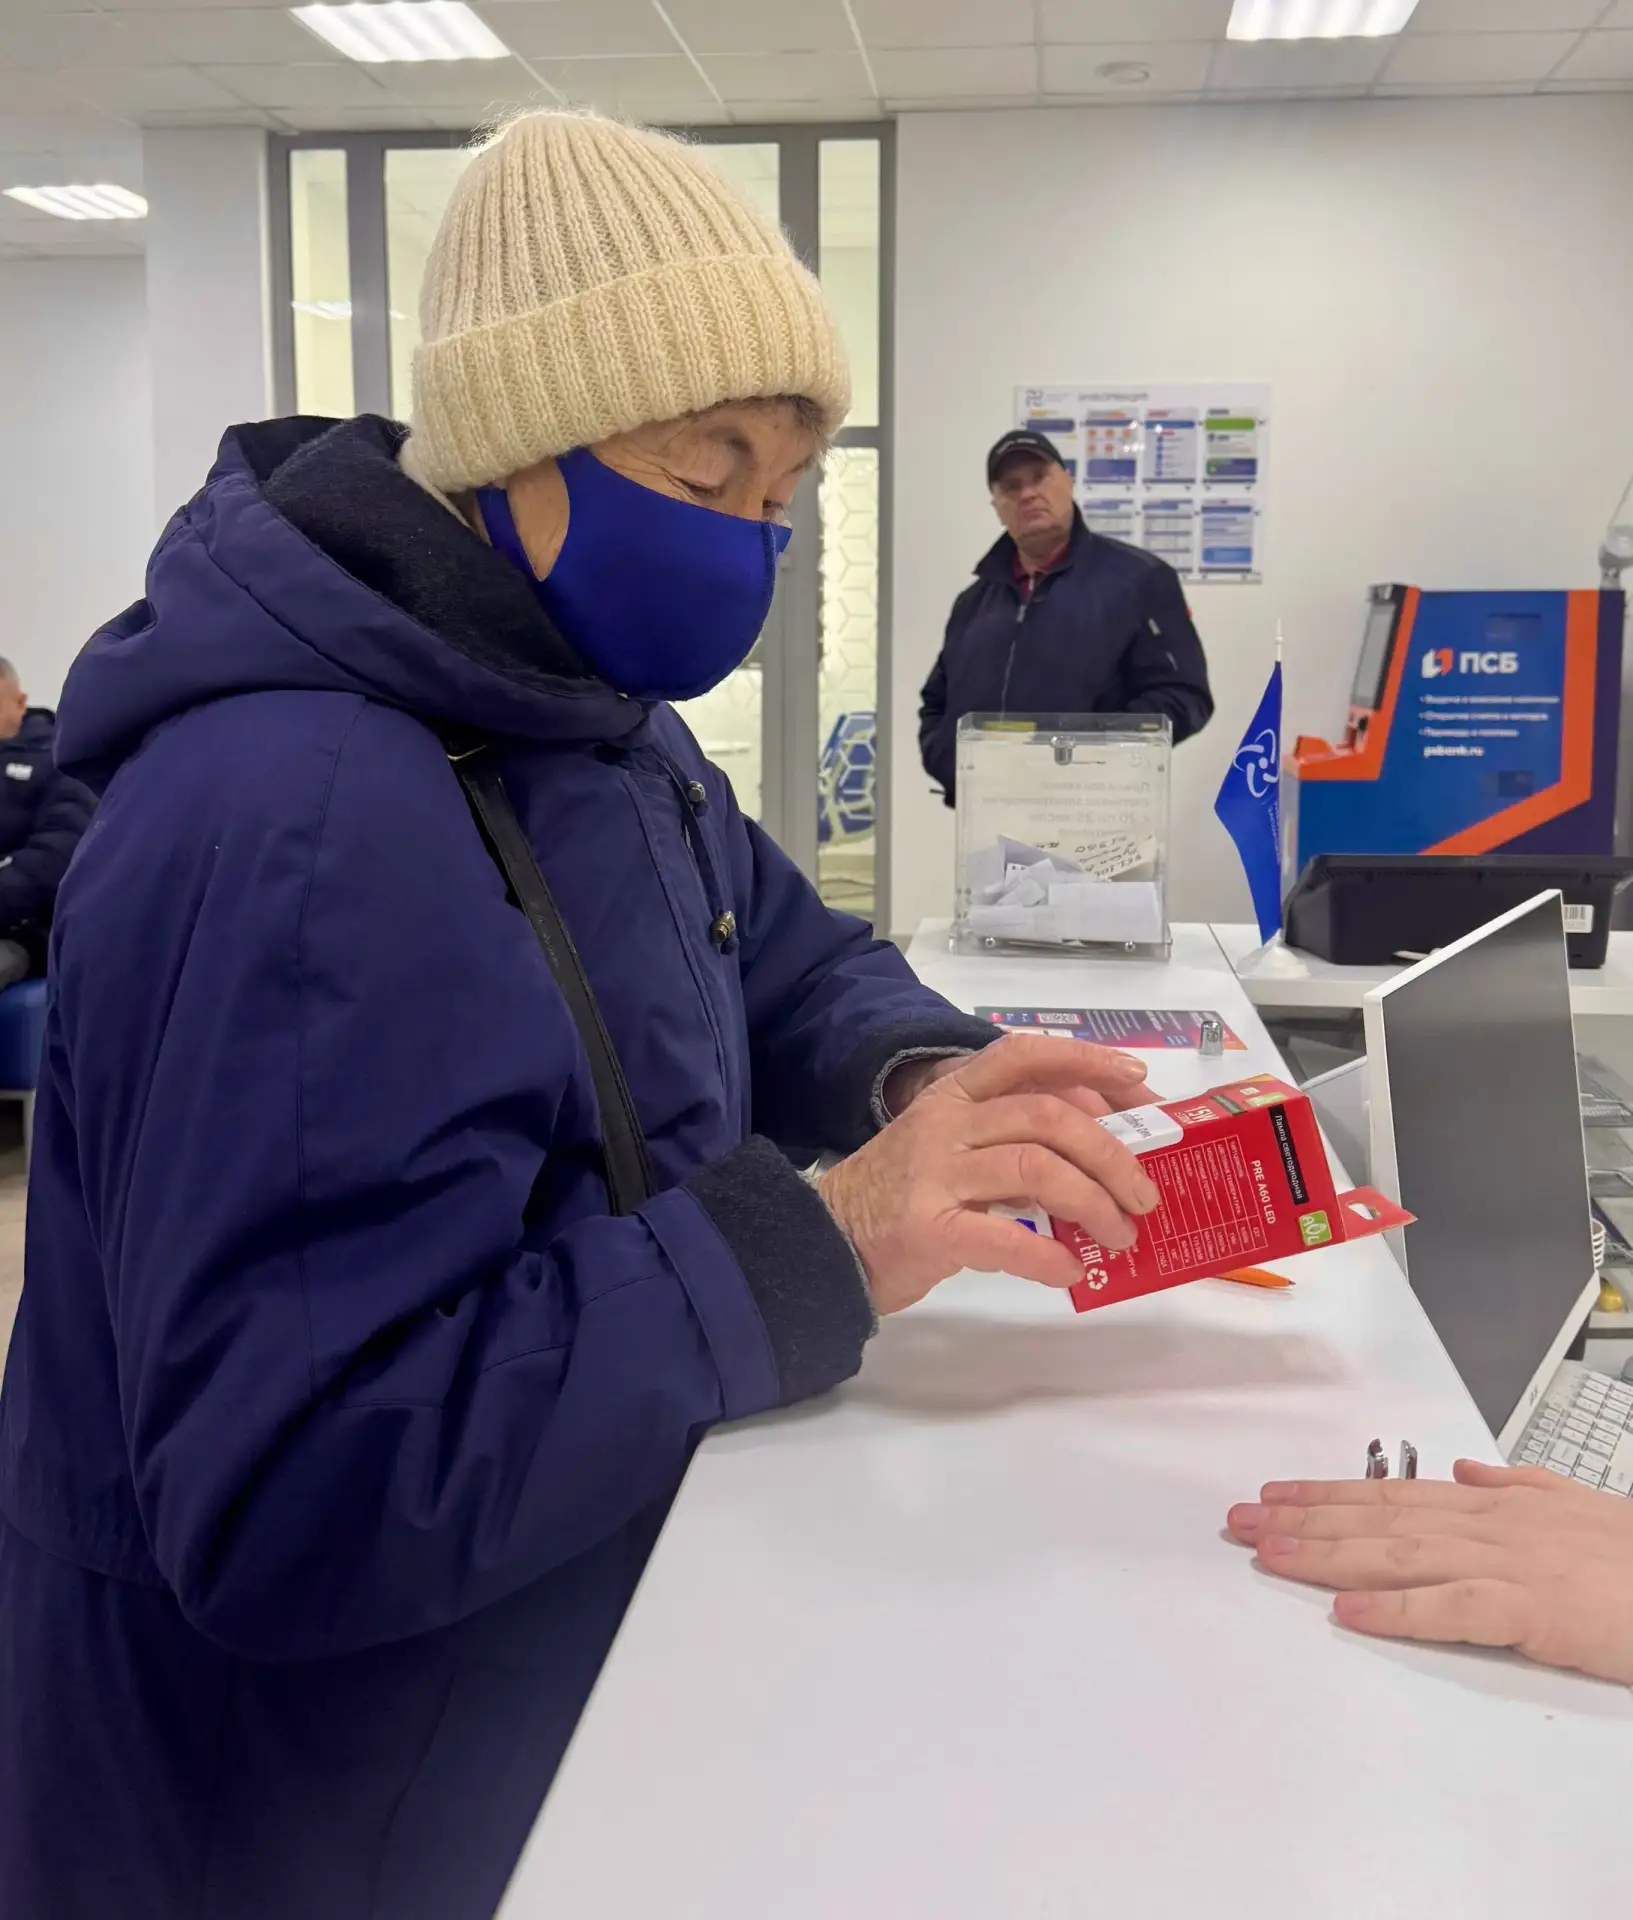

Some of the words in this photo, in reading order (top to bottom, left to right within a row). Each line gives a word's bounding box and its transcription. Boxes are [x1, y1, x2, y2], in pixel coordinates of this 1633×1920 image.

[1459, 652, 1519, 674] ПСБ
[1274, 1114, 1286, 1141] Лампа
[1281, 1143, 1303, 1199] светодиодная
[1251, 1159, 1264, 1181] PRE
[1257, 1181, 1270, 1202] A60
[1263, 1203, 1276, 1224] LED
